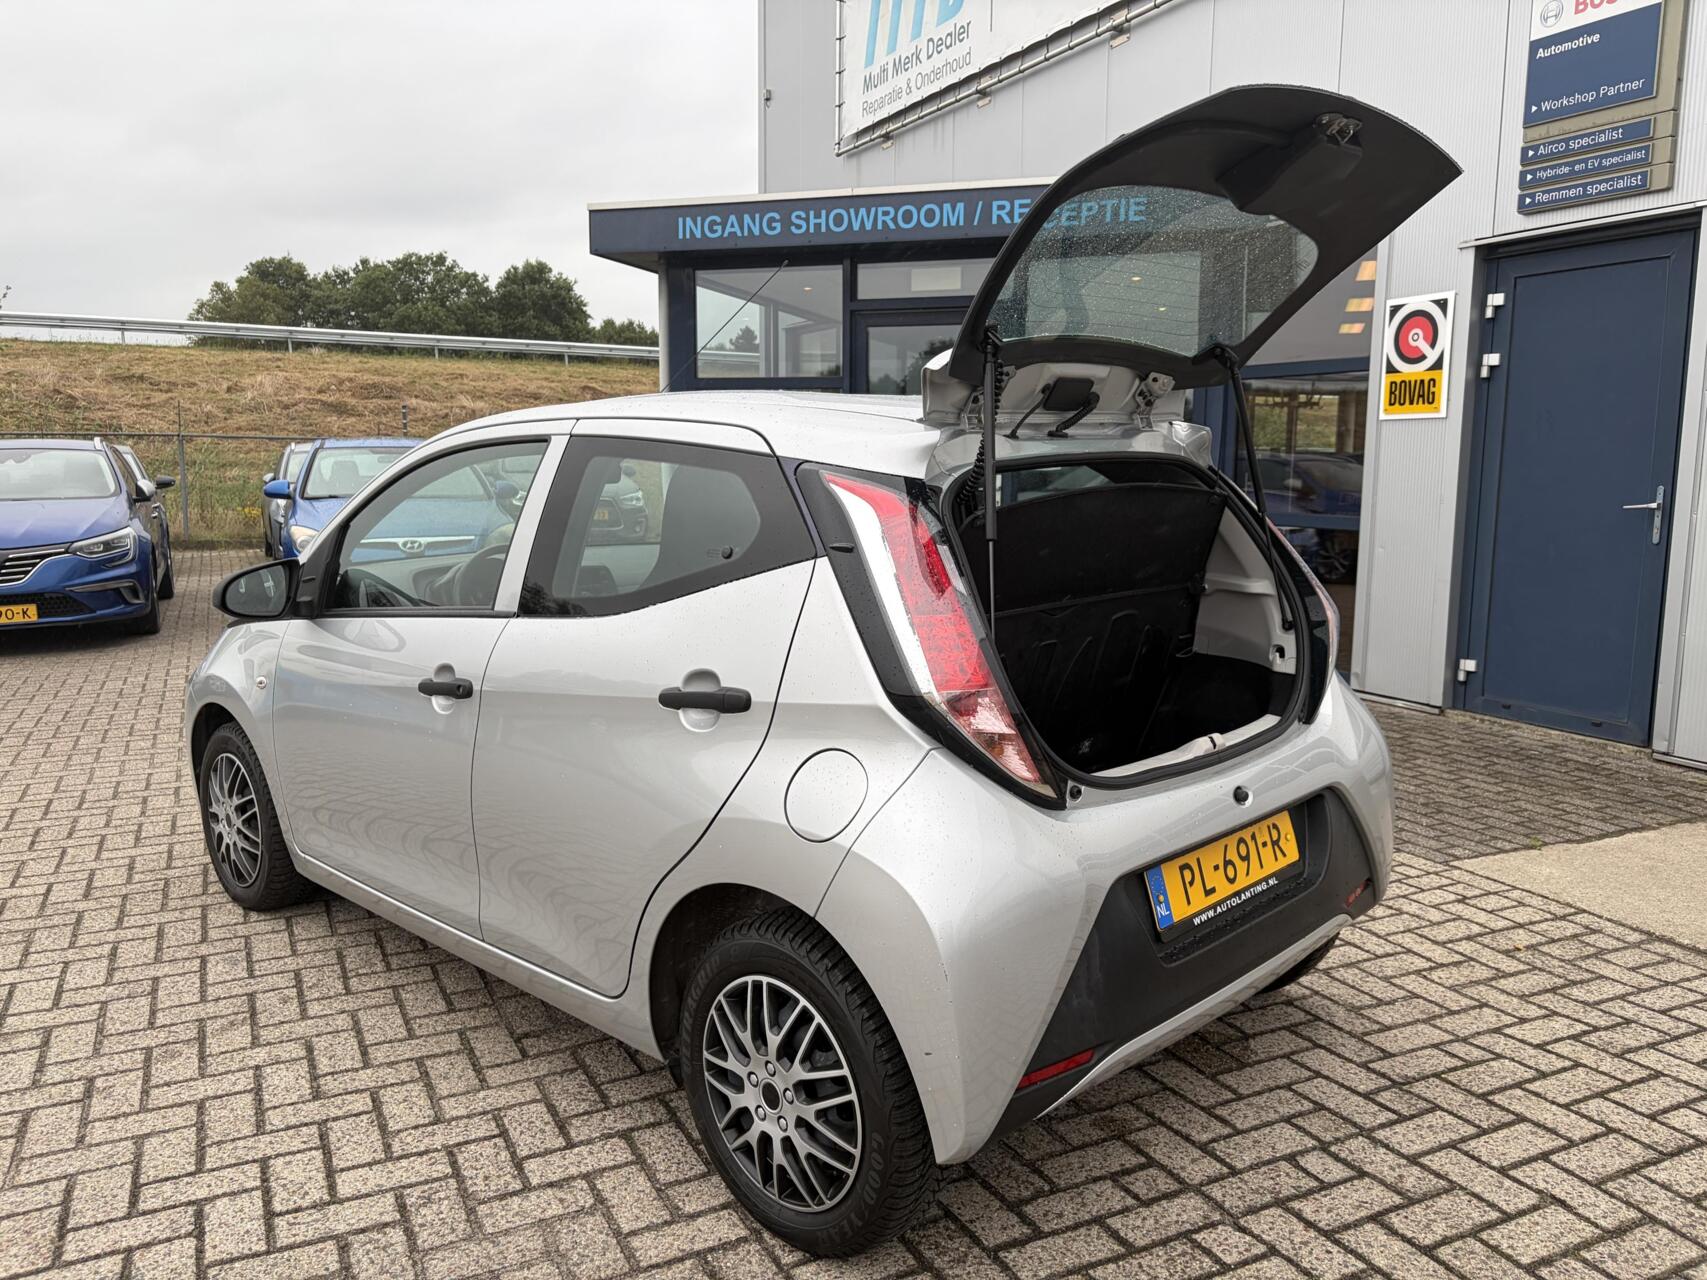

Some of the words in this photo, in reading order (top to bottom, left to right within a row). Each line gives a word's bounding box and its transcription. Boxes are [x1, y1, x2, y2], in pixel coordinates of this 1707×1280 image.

[862, 61, 889, 95] Multi
[892, 44, 922, 80] Merk
[926, 20, 972, 61] Dealer
[1536, 32, 1600, 59] Automotive
[862, 84, 903, 118] Reparatie
[905, 78, 912, 95] &
[915, 46, 972, 90] Onderhoud
[1541, 89, 1596, 112] Workshop
[1600, 78, 1645, 98] Partner
[1537, 142, 1566, 156] Airco
[1568, 128, 1623, 150] specialist
[1536, 165, 1573, 180] Hybride-
[1574, 162, 1585, 172] en
[1588, 159, 1600, 169] EV
[1601, 150, 1646, 167] specialist
[1535, 187, 1583, 204] Remmen
[1586, 175, 1642, 196] specialist
[677, 211, 782, 240] INGANG
[790, 202, 965, 236] SHOWROOM
[973, 201, 984, 227] /
[991, 195, 1150, 230] REEPTIE
[1388, 378, 1437, 407] BOVAG
[1178, 821, 1287, 907] PL-691-R
[1156, 902, 1170, 918] NL
[1193, 877, 1279, 926] WWW.AUTOLANTING.NL
